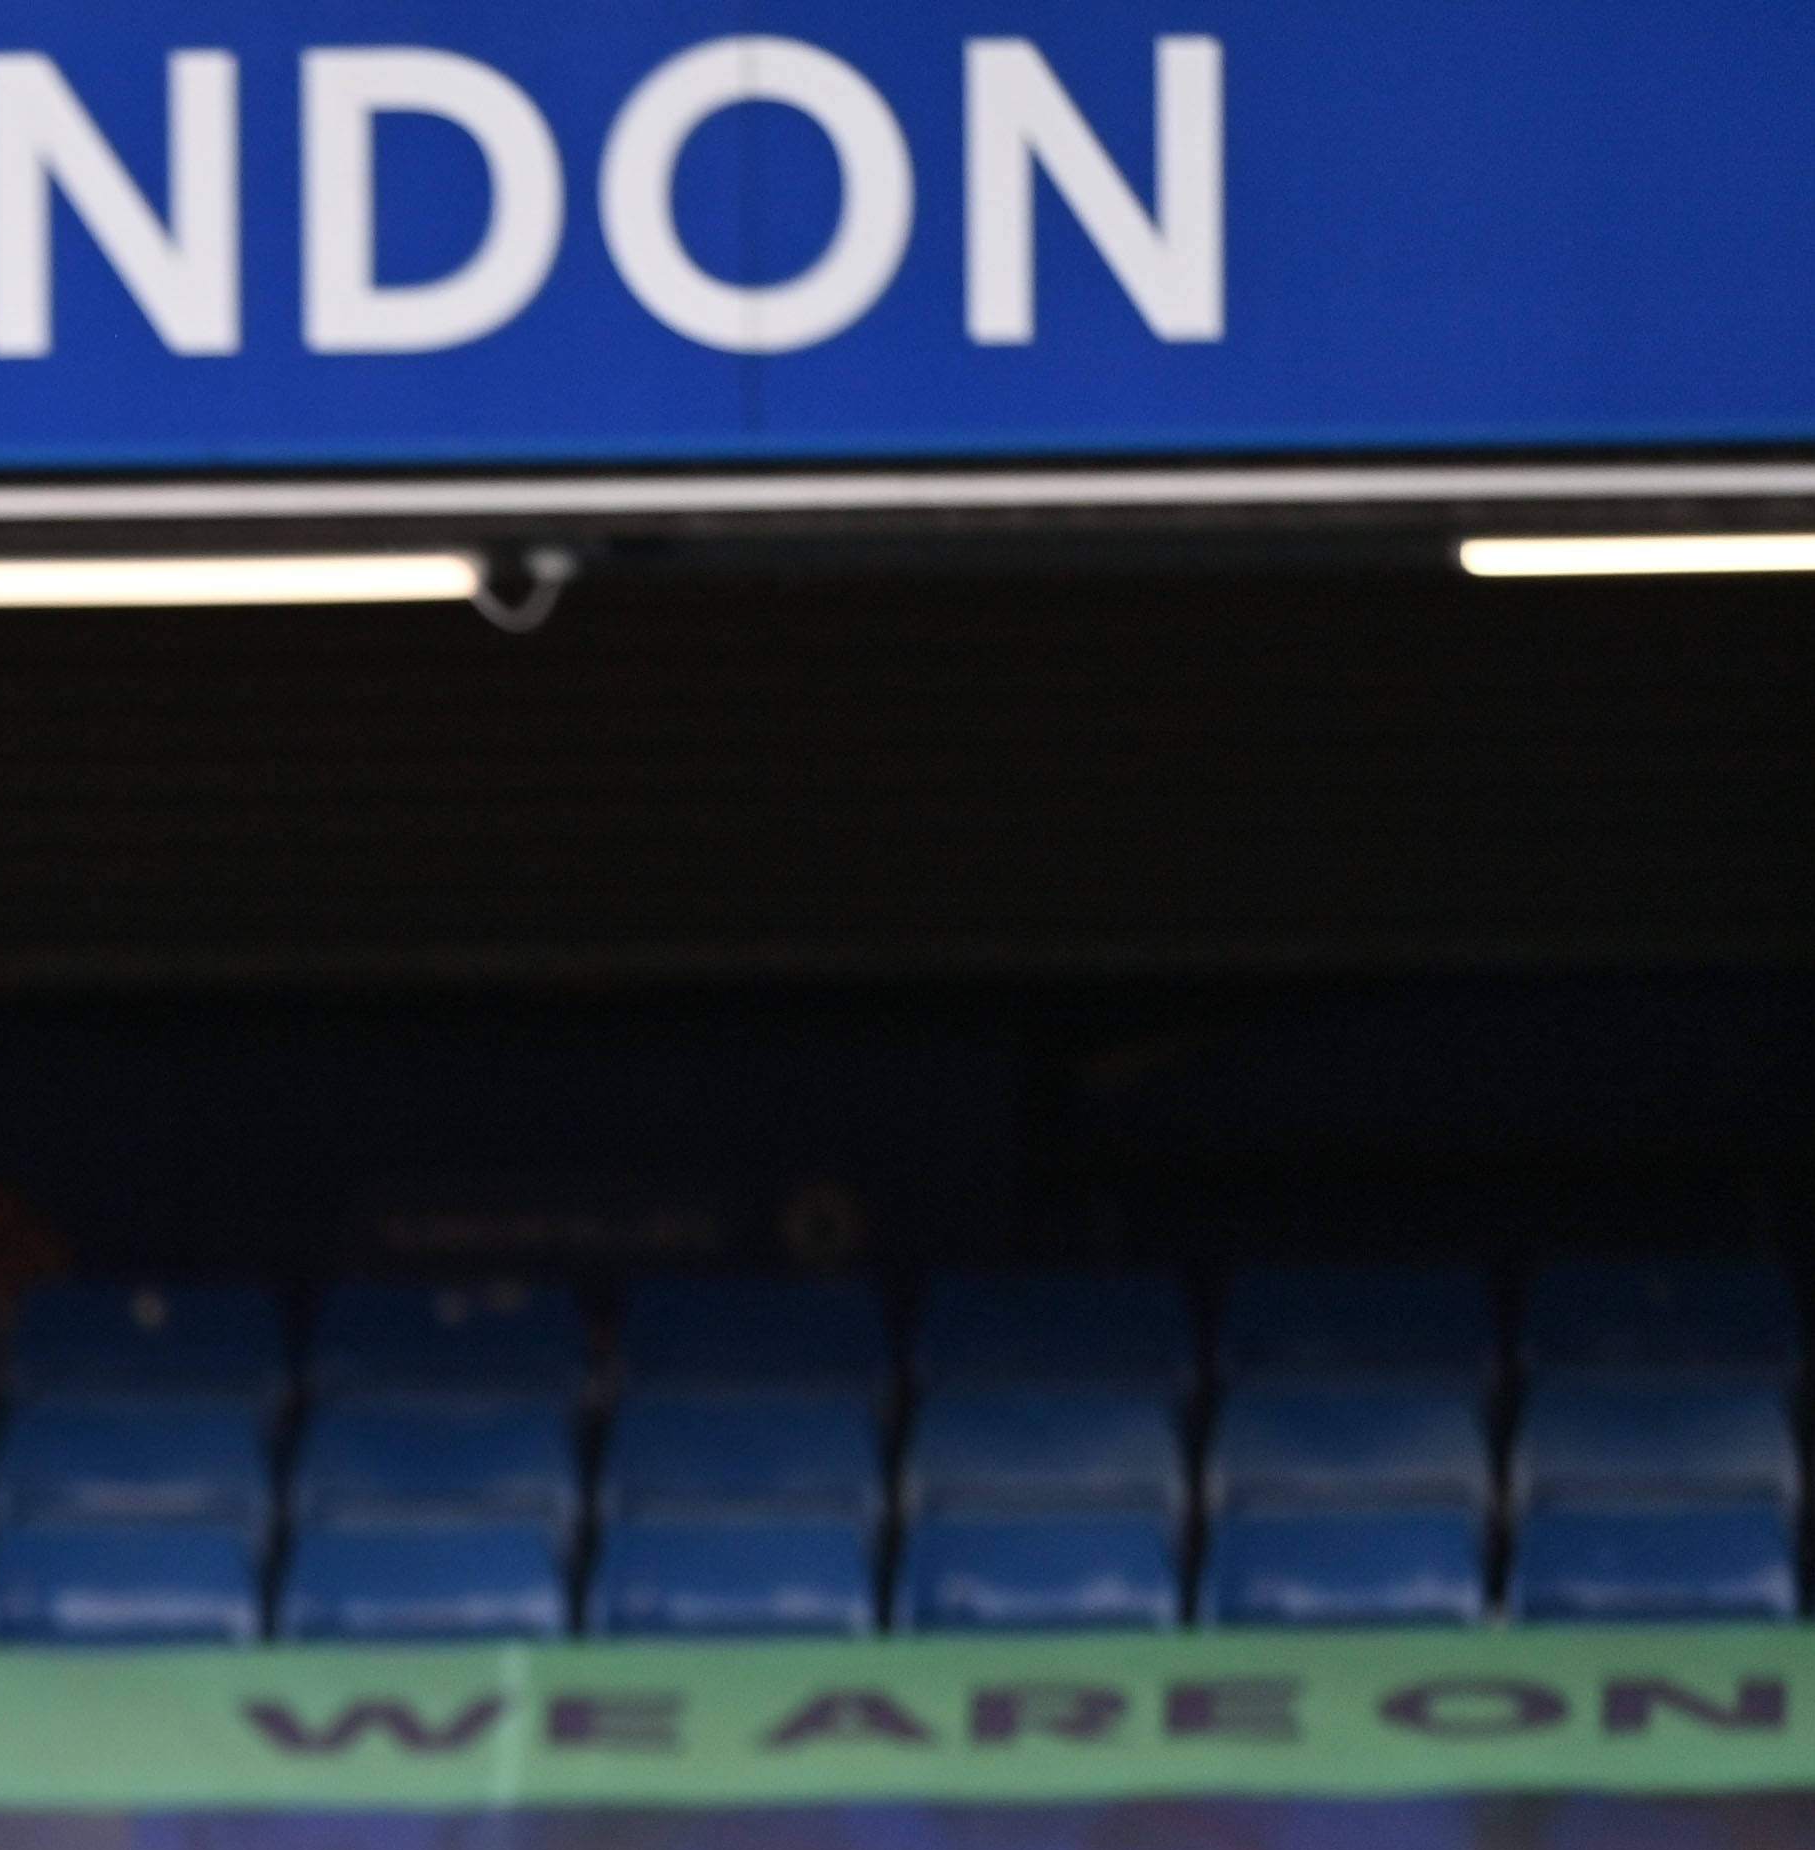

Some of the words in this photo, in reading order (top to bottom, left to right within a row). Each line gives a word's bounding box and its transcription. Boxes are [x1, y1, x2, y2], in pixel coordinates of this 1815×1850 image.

[241, 1692, 684, 1754] WE
[757, 1677, 1303, 1748] ARE
[1379, 1673, 1789, 1740] ON
